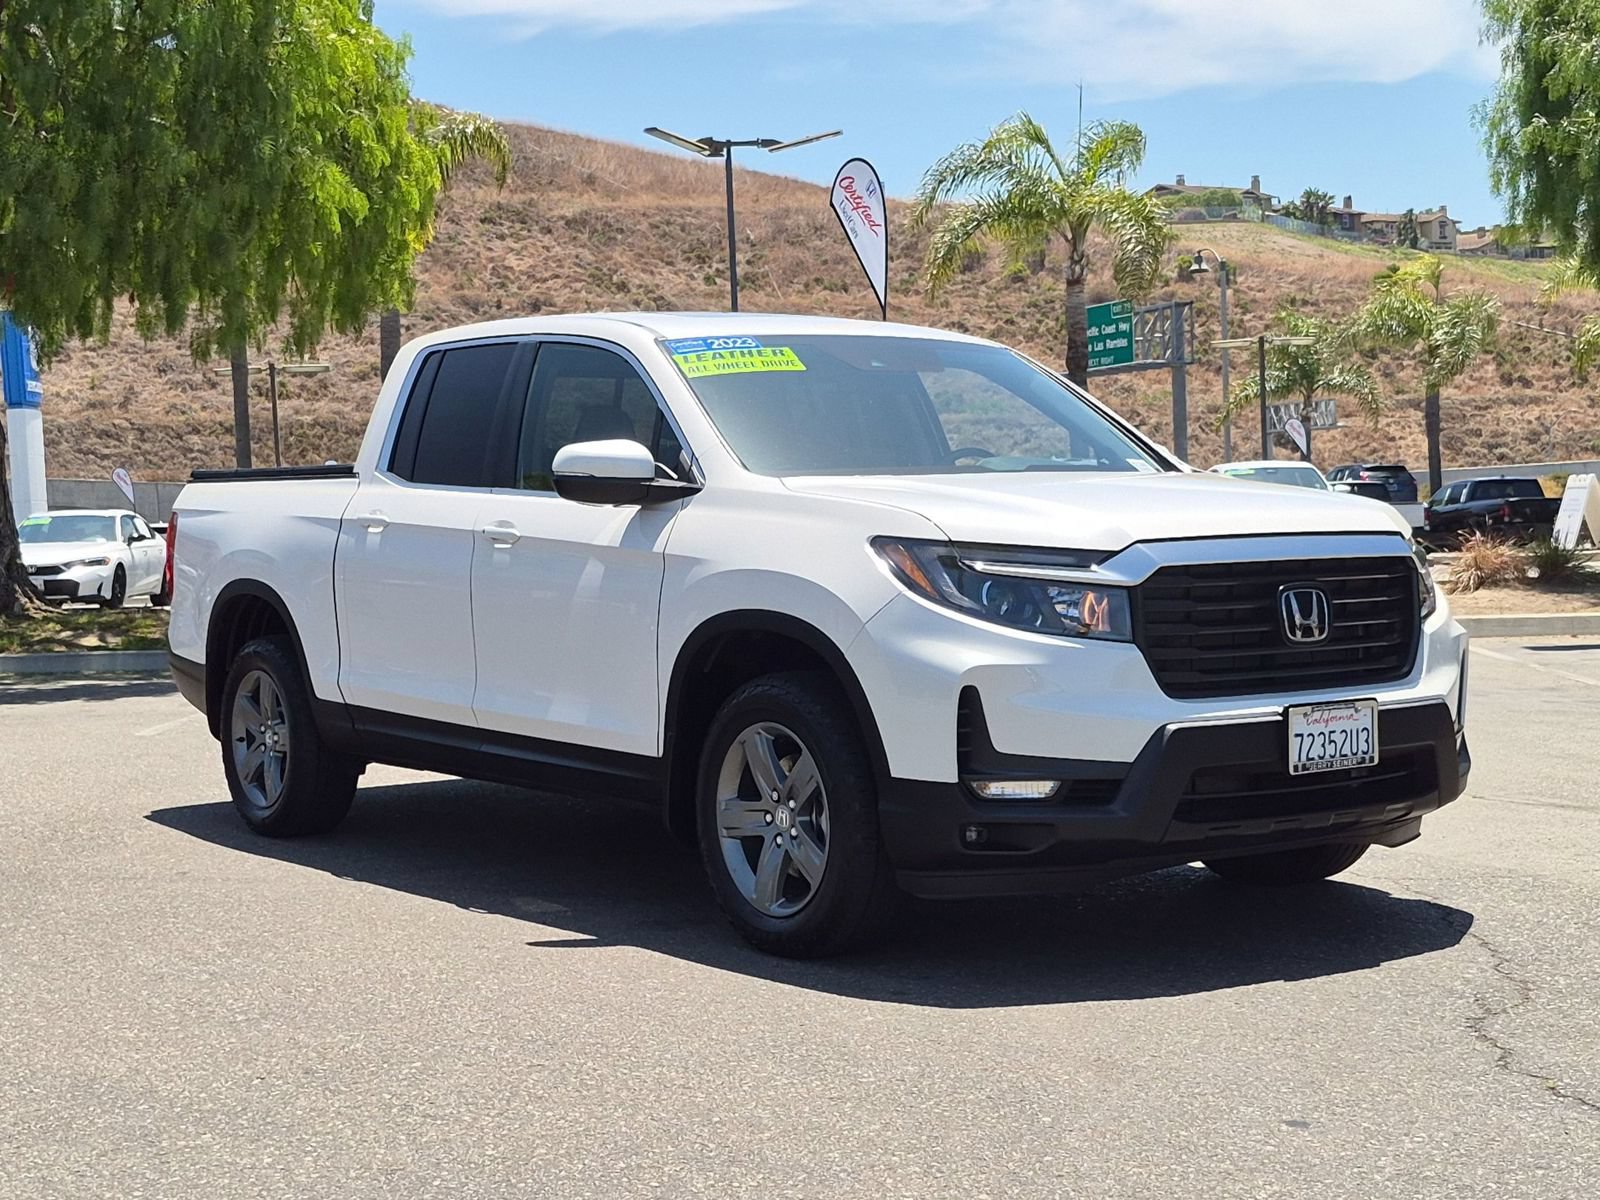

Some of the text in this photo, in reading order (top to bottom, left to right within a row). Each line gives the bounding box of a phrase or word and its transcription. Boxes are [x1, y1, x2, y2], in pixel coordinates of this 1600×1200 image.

[839, 176, 882, 237] Certified
[1101, 324, 1116, 335] Coast
[1119, 321, 1130, 333] Hwy
[707, 337, 757, 349] 2023
[1094, 341, 1104, 351] Las
[682, 348, 786, 364] LEATHER
[688, 359, 799, 374] ALL WHEEL DRIVE
[1306, 709, 1359, 728] California
[1294, 726, 1370, 762] 72352U3
